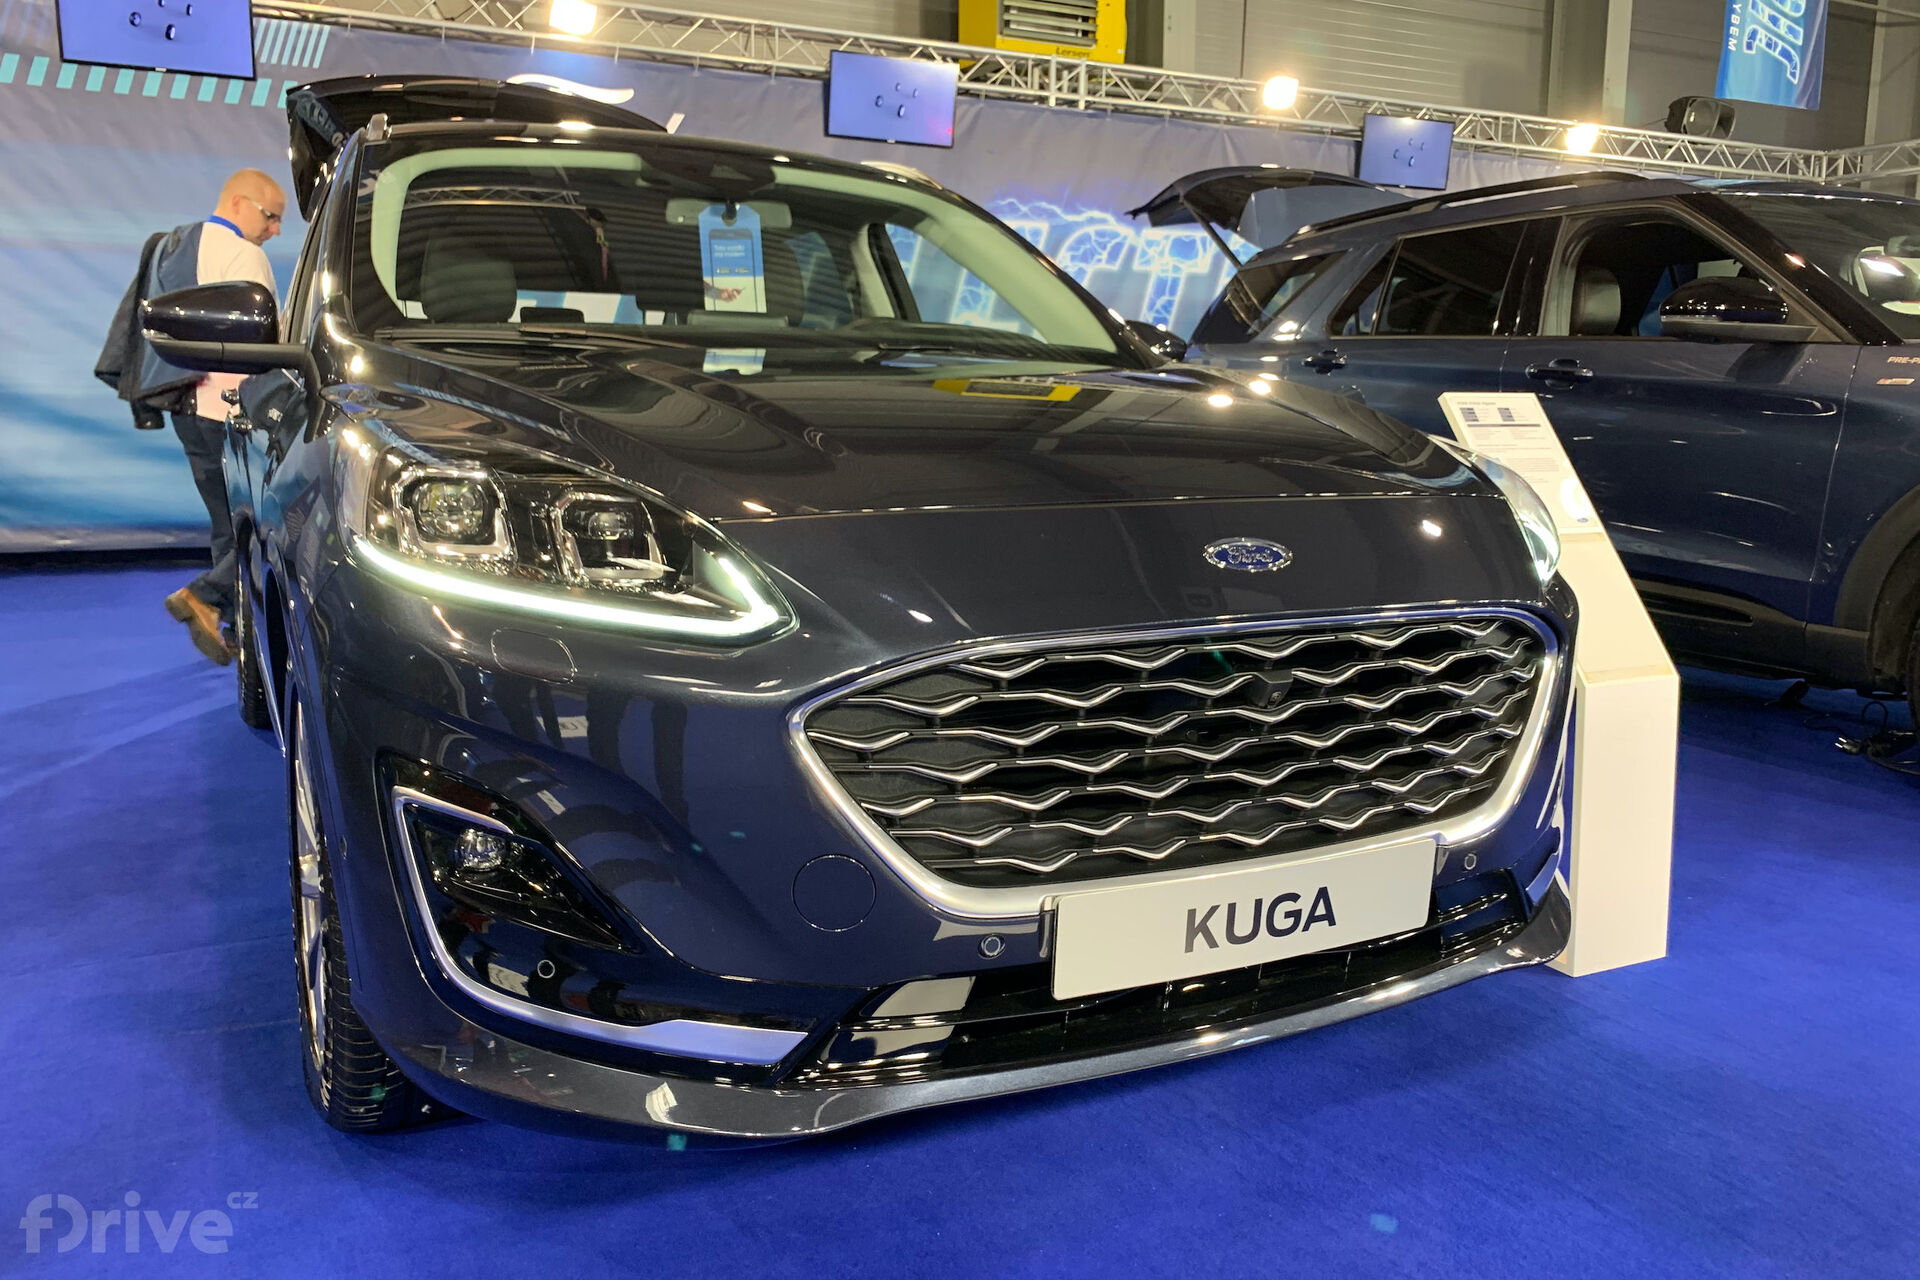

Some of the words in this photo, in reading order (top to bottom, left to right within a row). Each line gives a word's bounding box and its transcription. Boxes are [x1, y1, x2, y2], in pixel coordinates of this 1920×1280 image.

[1887, 356, 1920, 364] PRE-P
[1227, 545, 1273, 564] Ford
[1184, 886, 1337, 953] KUGA
